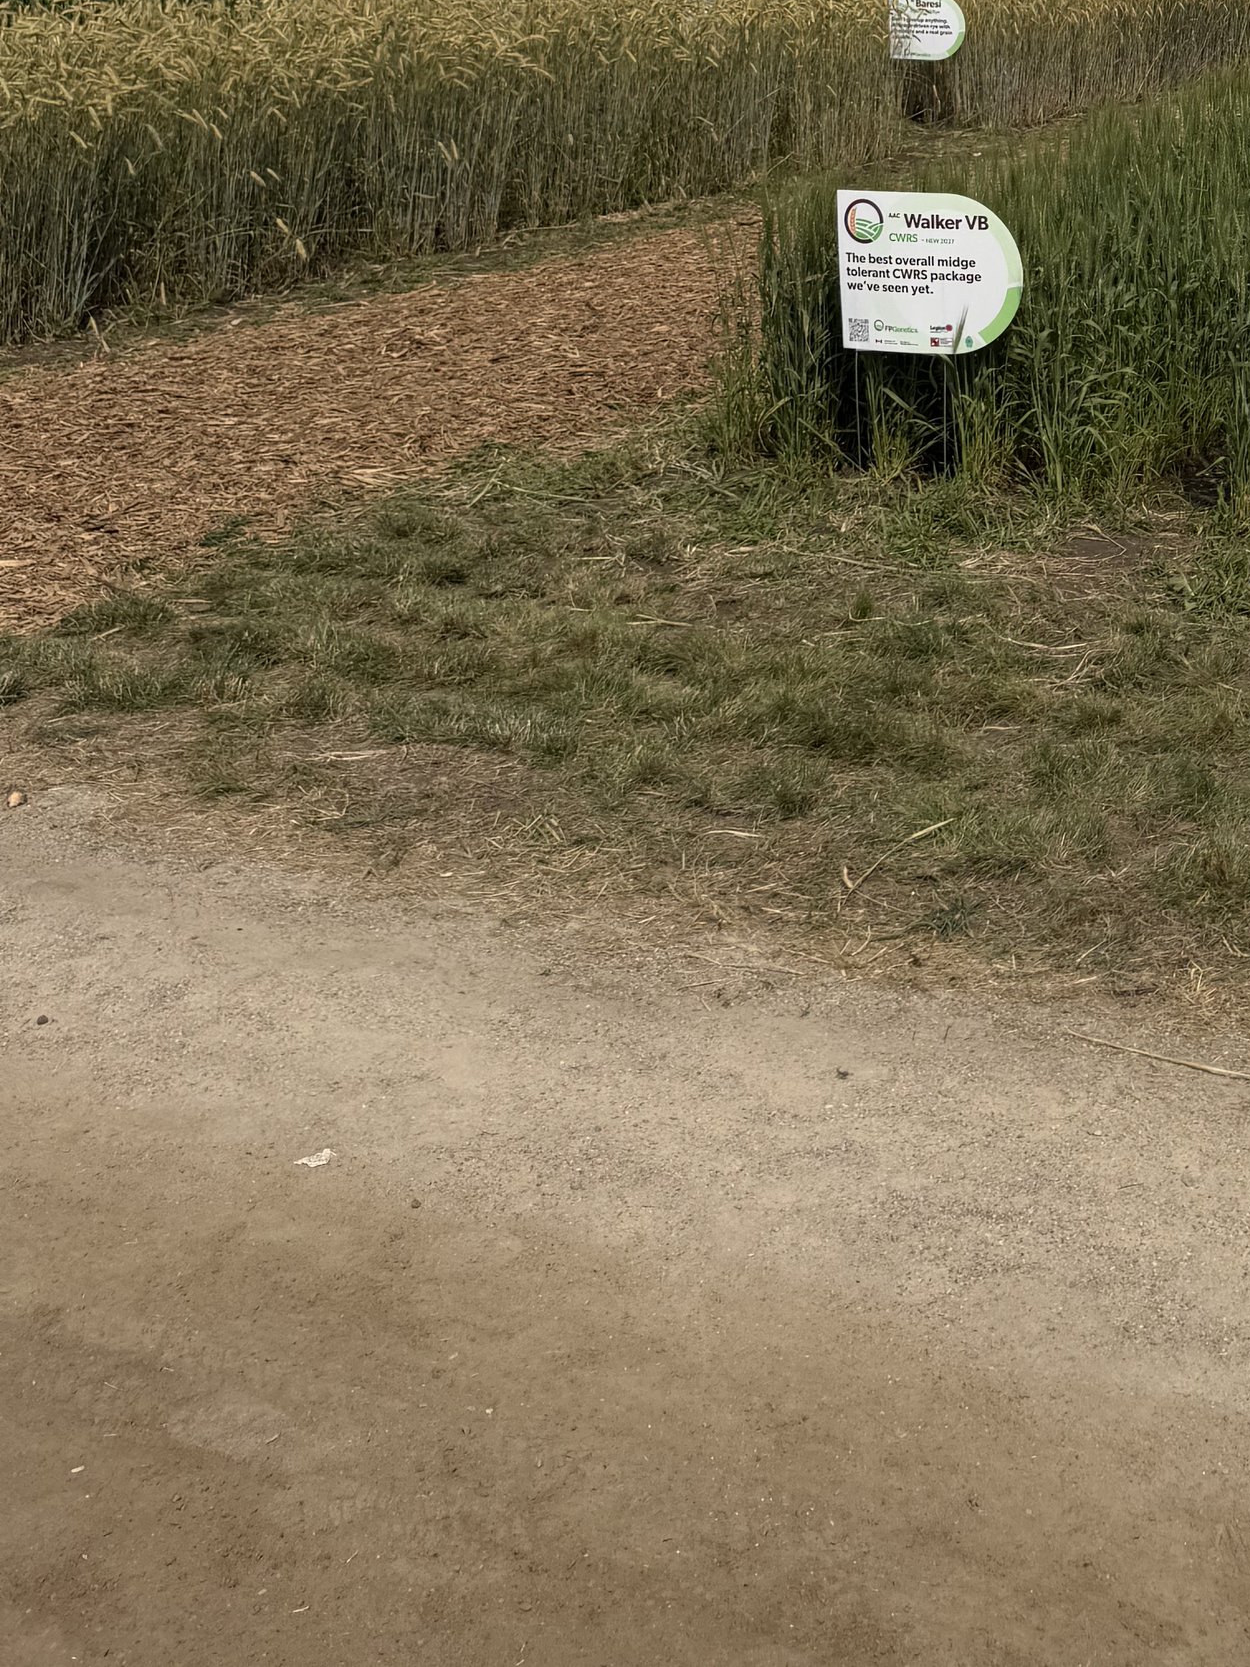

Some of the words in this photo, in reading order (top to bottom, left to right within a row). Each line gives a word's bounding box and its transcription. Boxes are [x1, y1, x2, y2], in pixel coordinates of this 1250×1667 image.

[903, 213, 962, 230] Walker
[965, 215, 989, 231] VB
[889, 233, 918, 243] CWRS
[845, 252, 866, 264] The
[868, 253, 893, 265] best
[895, 256, 935, 267] overall
[937, 257, 976, 270] midge
[846, 267, 890, 279] tolerant
[892, 269, 928, 280] CWRS
[930, 270, 982, 284] package
[847, 281, 880, 292] we've
[882, 283, 909, 293] seen
[911, 284, 934, 296] yet.
